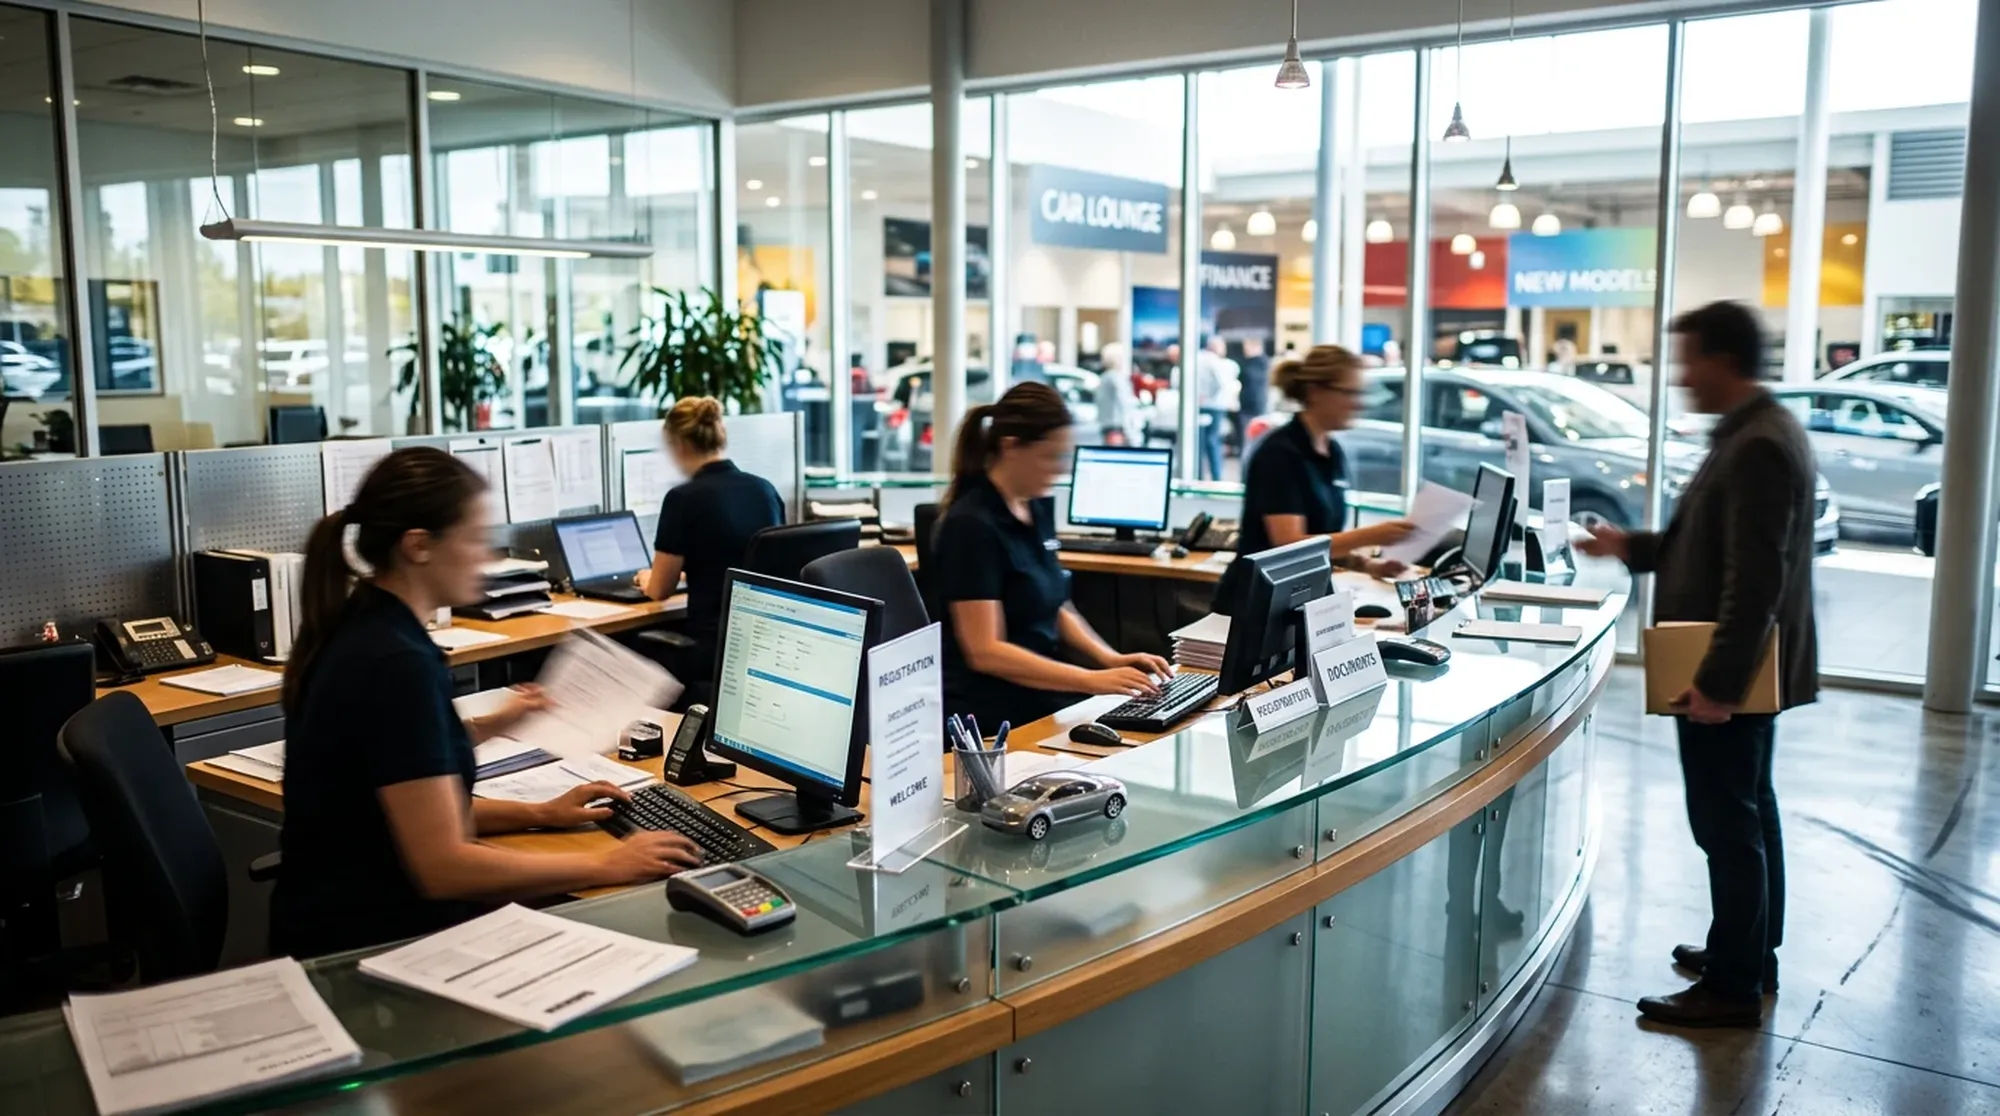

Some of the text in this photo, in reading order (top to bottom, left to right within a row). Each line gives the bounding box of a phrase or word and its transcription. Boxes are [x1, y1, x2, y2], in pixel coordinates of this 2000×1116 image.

[1040, 188, 1163, 235] CAR LOUNGE
[1199, 264, 1272, 290] FINANCE
[1515, 269, 1657, 294] NEW MODELS
